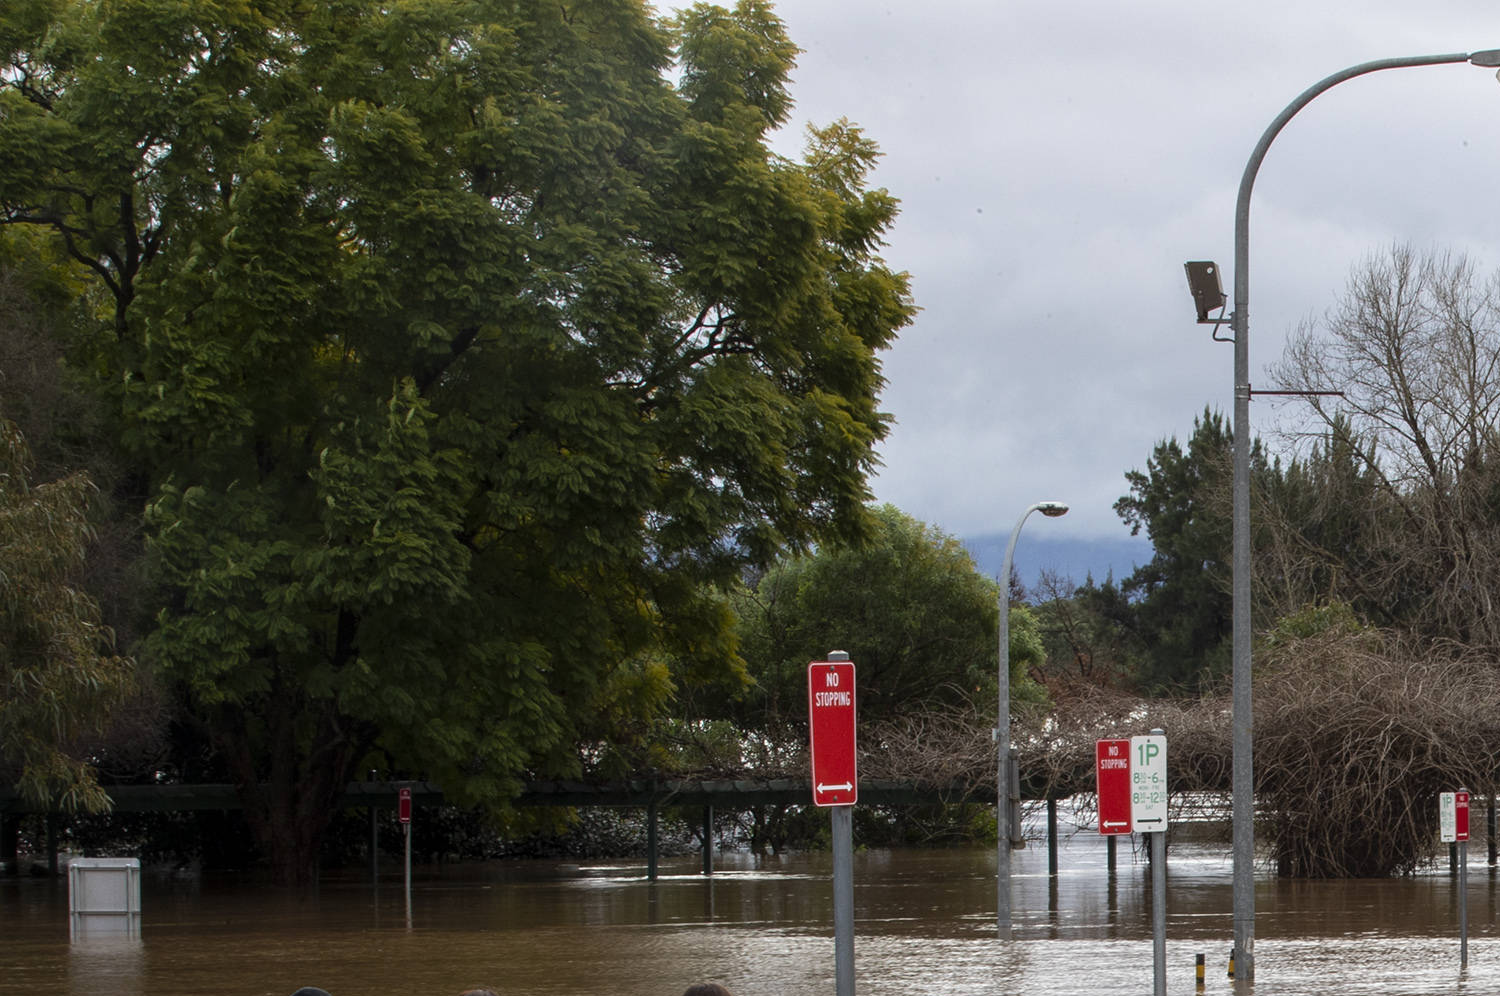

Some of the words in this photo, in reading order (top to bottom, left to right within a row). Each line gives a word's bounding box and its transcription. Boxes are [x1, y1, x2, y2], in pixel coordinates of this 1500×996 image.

[826, 673, 839, 687] NO
[815, 692, 851, 707] STOPPING
[1108, 746, 1119, 756] NO
[1137, 744, 1159, 766] 1P
[1100, 759, 1128, 769] STOPPING
